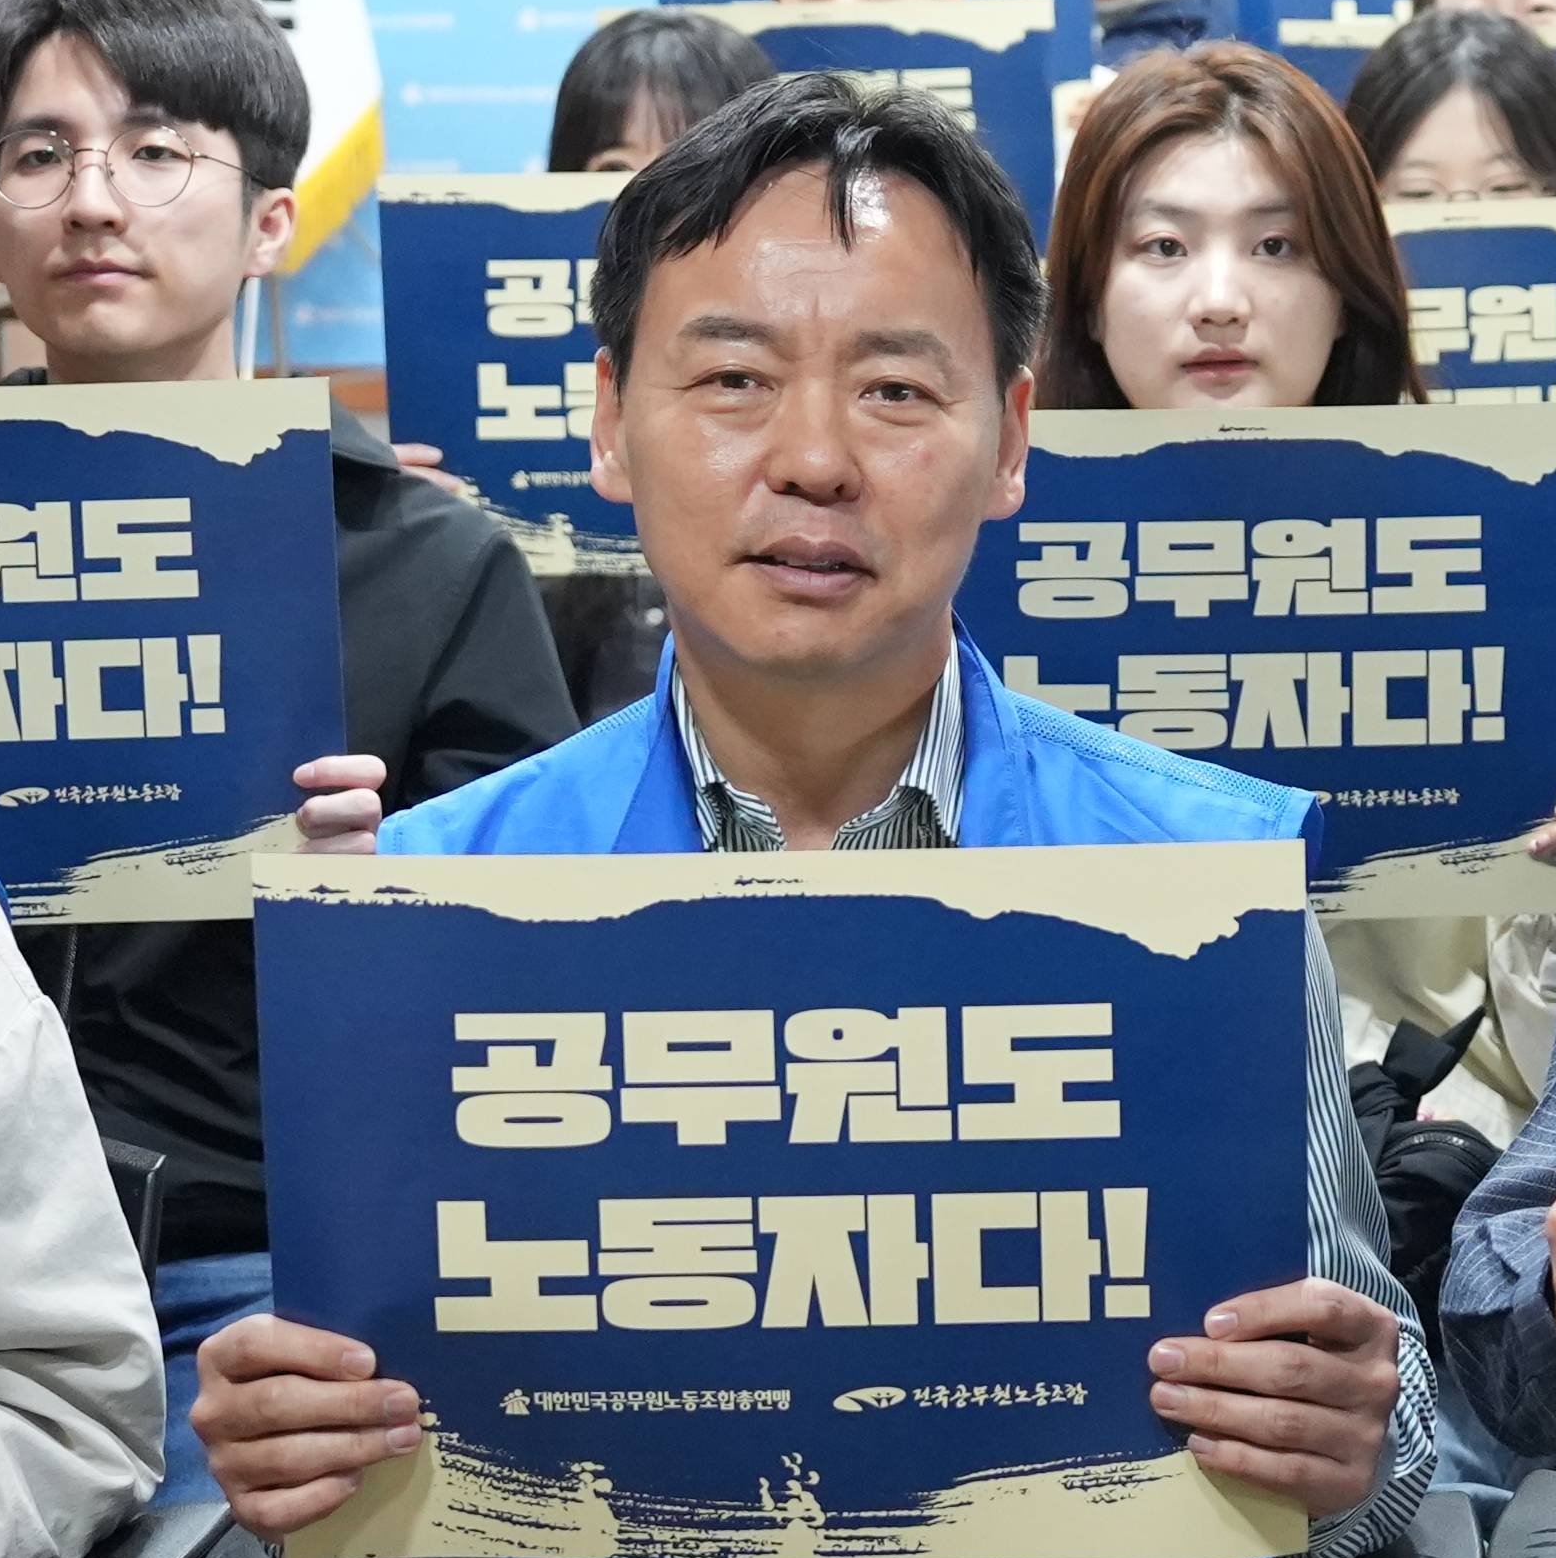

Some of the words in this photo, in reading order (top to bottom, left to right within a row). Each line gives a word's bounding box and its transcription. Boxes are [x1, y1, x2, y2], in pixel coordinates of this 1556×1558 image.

[1016, 516, 1486, 618] 공무원도
[452, 1003, 1120, 1148] 공무원도
[435, 1188, 1150, 1332] 노동자다!
[534, 1390, 790, 1411] 대한민국공무원노동조합총연맹
[913, 1382, 1088, 1408] 전국공무원노동조합
